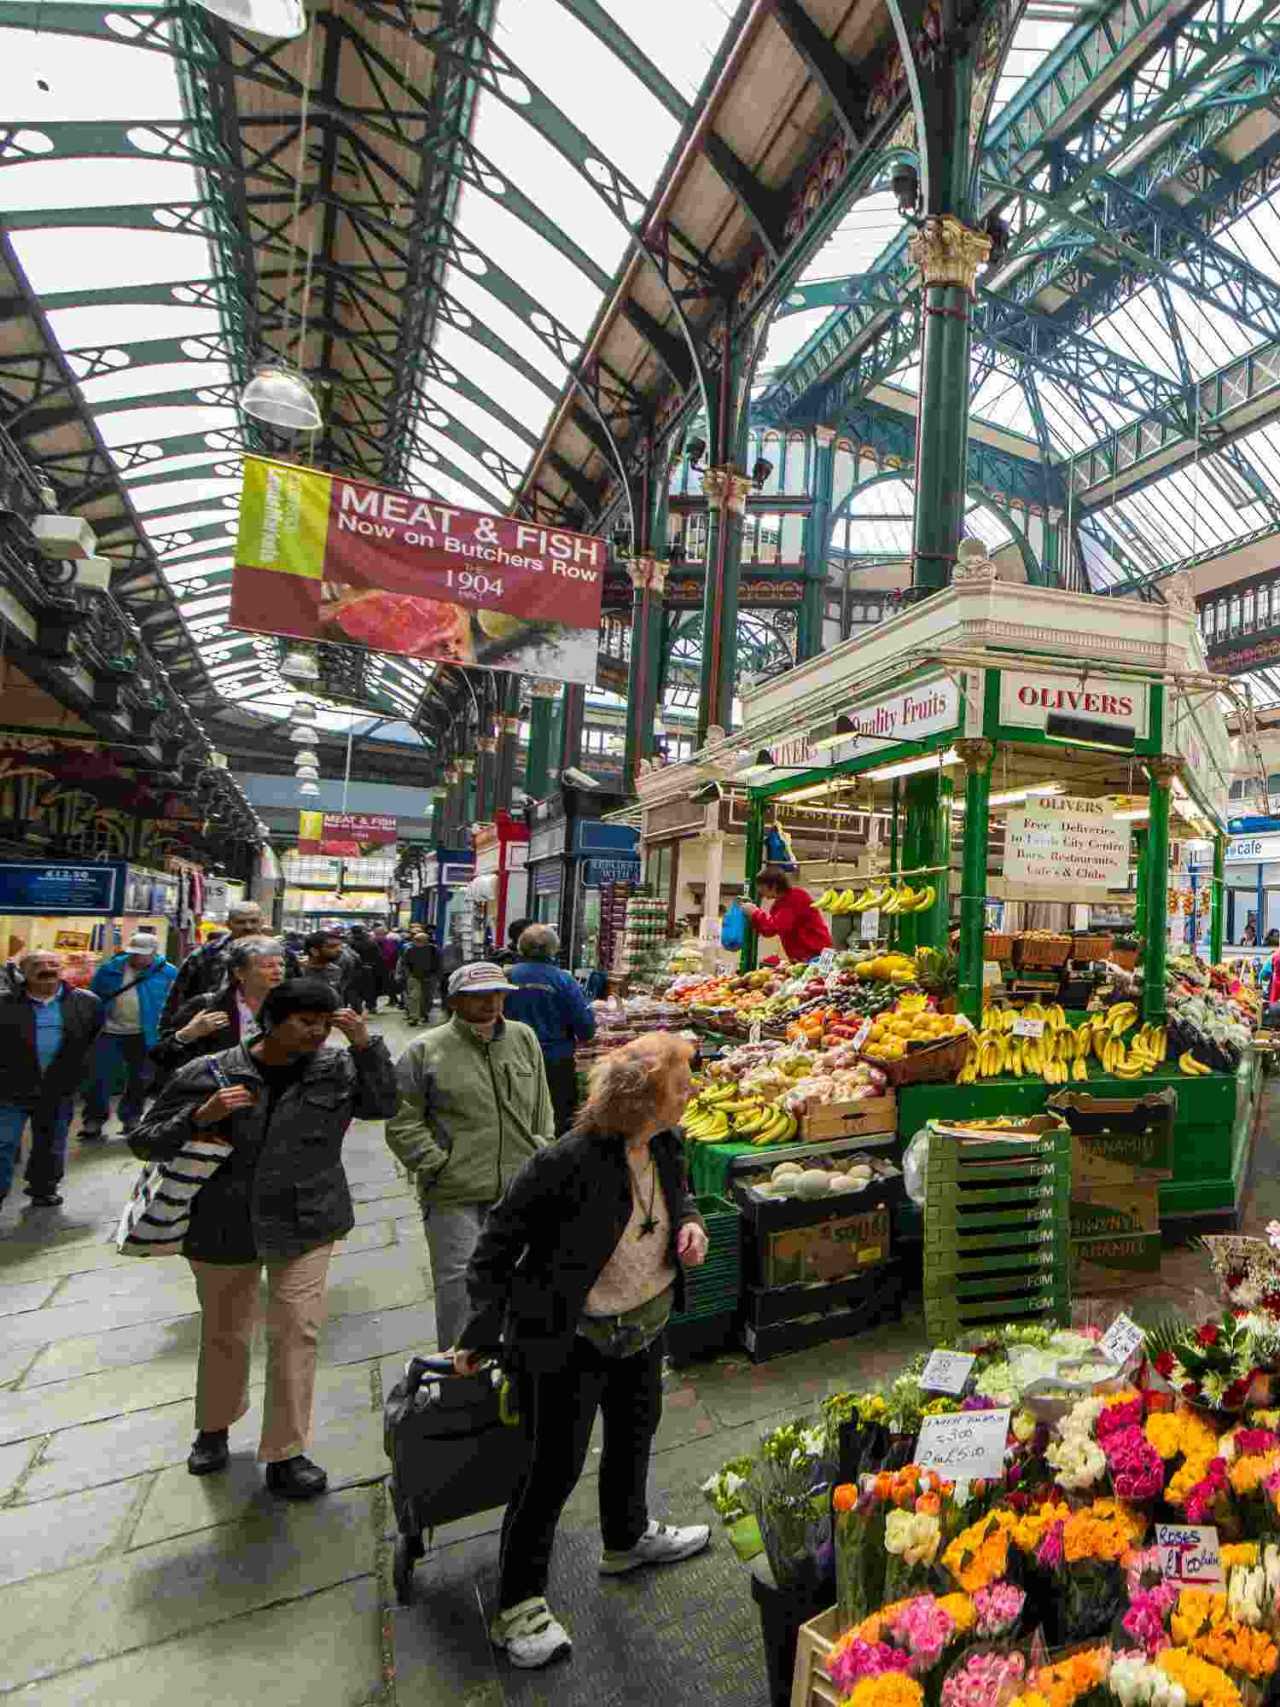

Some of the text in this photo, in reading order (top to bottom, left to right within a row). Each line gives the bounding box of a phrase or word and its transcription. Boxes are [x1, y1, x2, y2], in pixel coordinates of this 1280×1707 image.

[341, 485, 460, 534] MEAT
[474, 517, 499, 545] &
[516, 525, 600, 566] FISH
[337, 512, 598, 584] Now on Butchers Row
[444, 569, 504, 597] 1904
[1017, 686, 1134, 717] OLIVERS
[853, 690, 947, 737] Quality Fruits
[1038, 798, 1105, 814] OLIVERS
[1023, 818, 1116, 835] Free Deliveries
[1063, 838, 1085, 850] City
[1237, 840, 1262, 856] cafe
[1063, 868, 1072, 878] &
